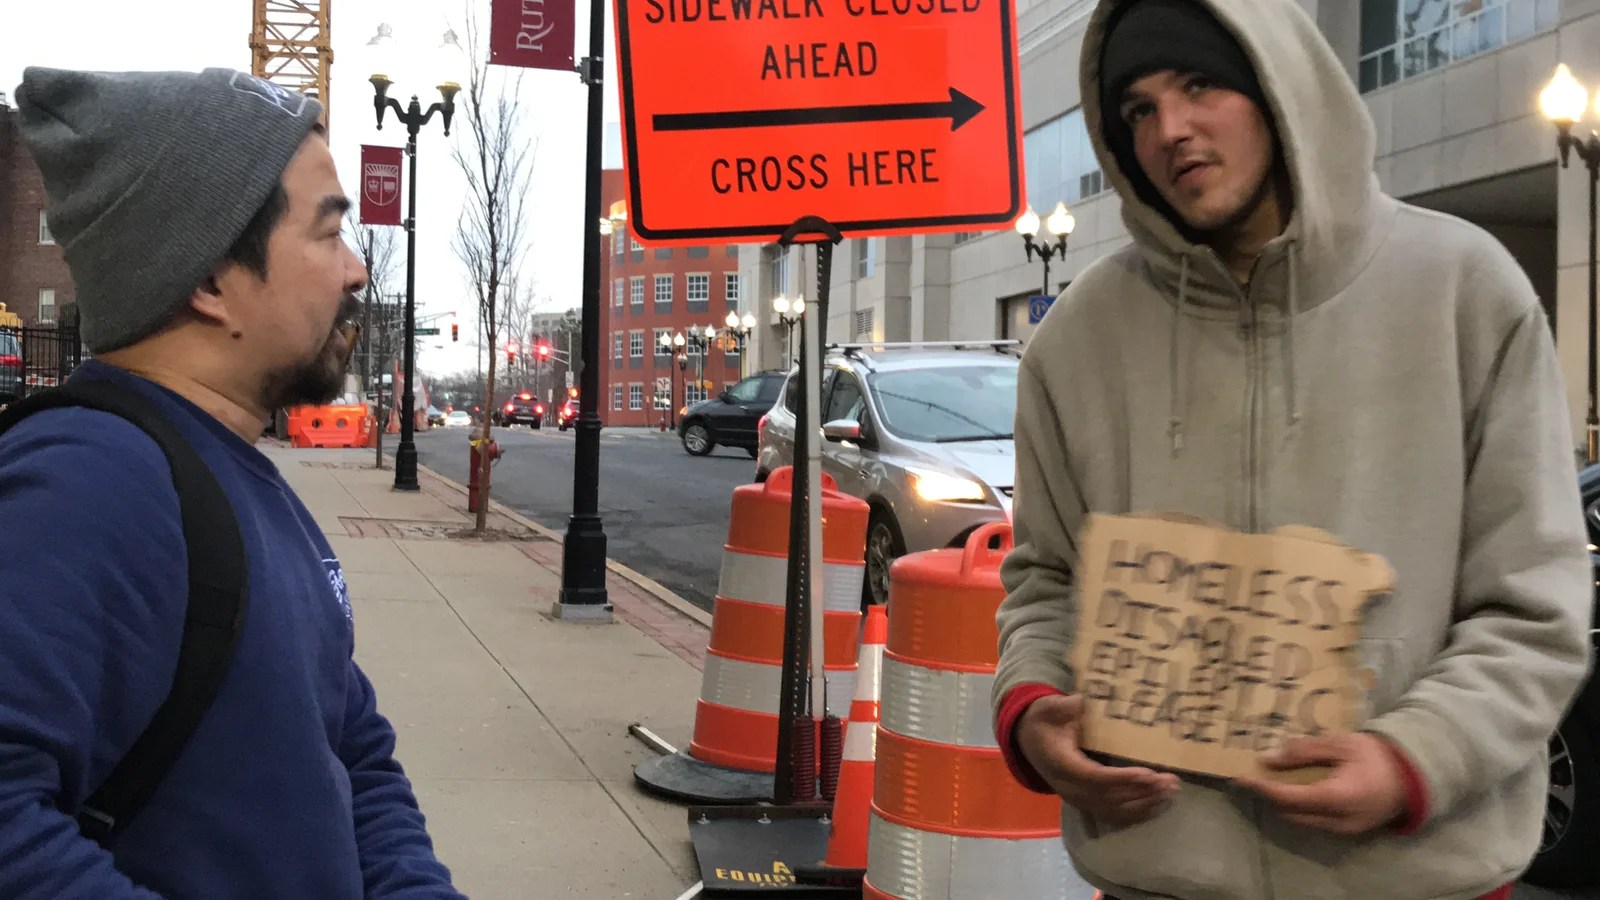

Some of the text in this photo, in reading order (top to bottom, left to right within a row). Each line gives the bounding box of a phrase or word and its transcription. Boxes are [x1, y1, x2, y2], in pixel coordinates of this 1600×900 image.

[645, 0, 825, 24] SIDEWALK
[761, 42, 877, 80] AHEAD
[711, 149, 940, 194] CROSS HERE
[1104, 540, 1344, 631] HOMELESS
[1096, 588, 1314, 681] DISABLED
